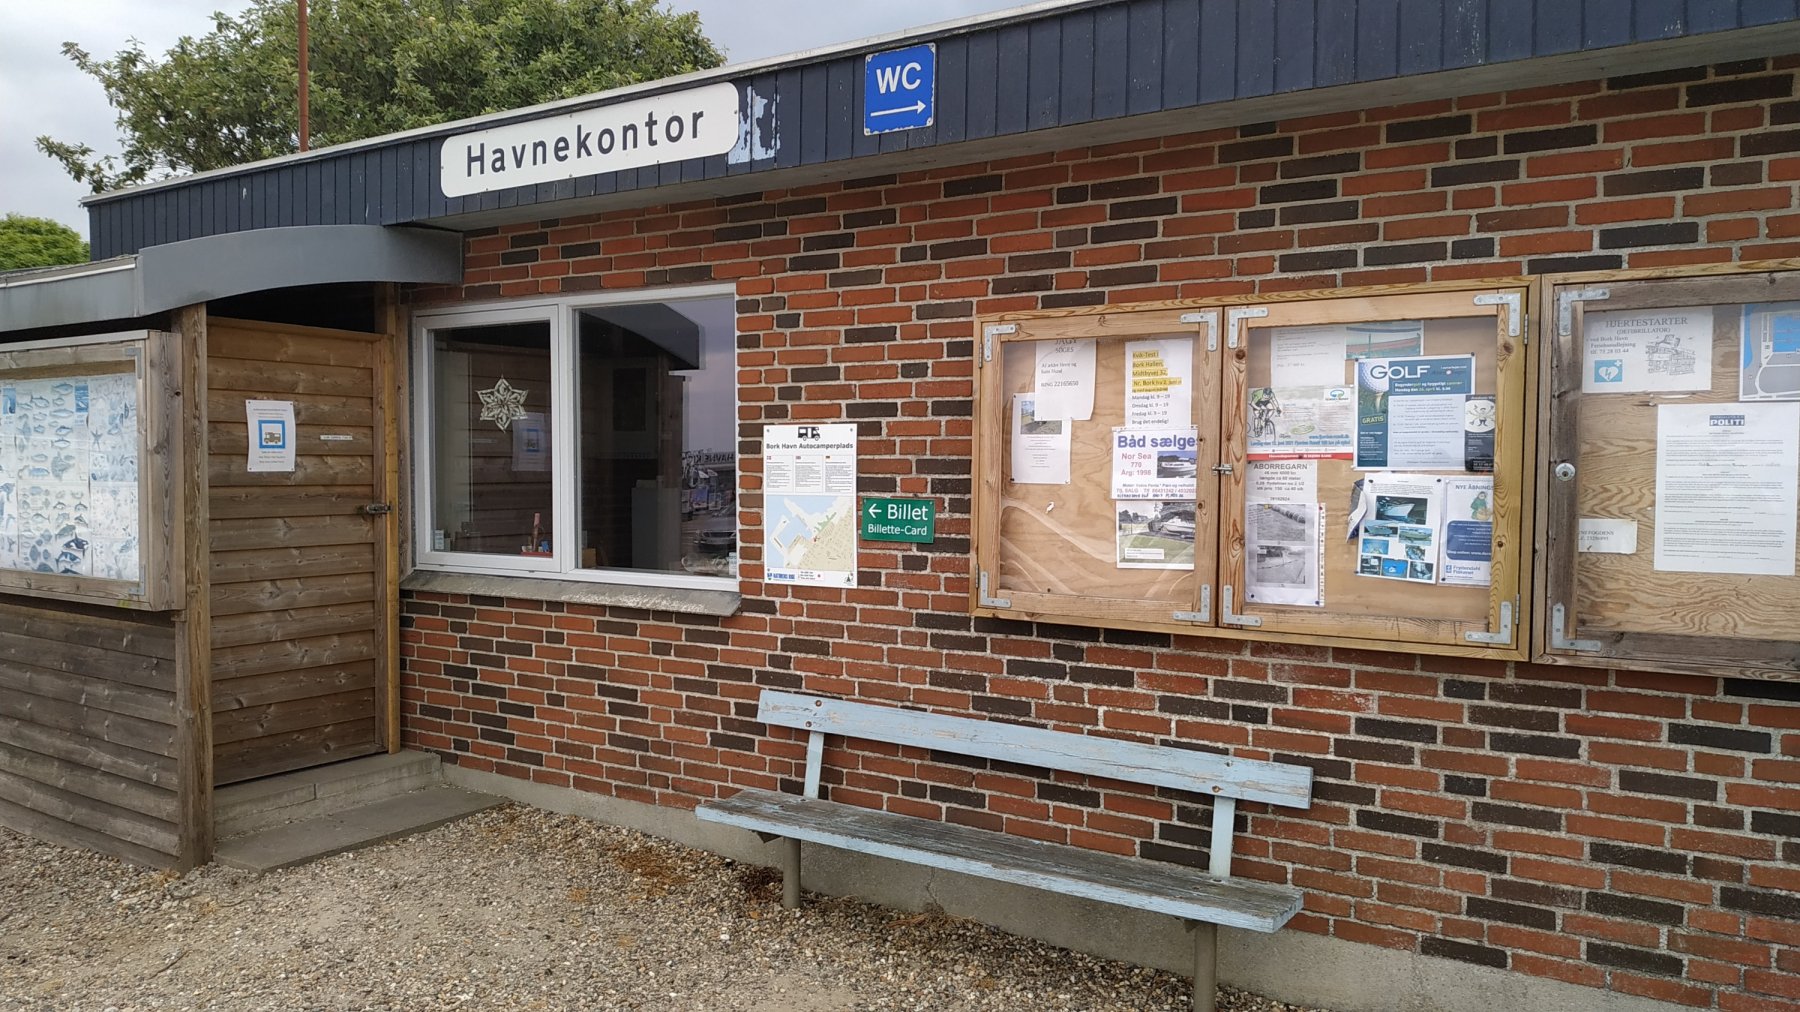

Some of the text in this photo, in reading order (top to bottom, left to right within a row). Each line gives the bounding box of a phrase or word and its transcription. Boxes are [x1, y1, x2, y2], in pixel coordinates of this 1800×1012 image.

[876, 62, 922, 94] WC
[466, 110, 704, 178] Havnekontor
[1606, 317, 1688, 328] HJERTESTARTER
[1370, 365, 1431, 380] GOLF
[1118, 434, 1146, 448] Båd
[887, 503, 929, 521] Billet
[867, 523, 928, 536] Billette-Card
